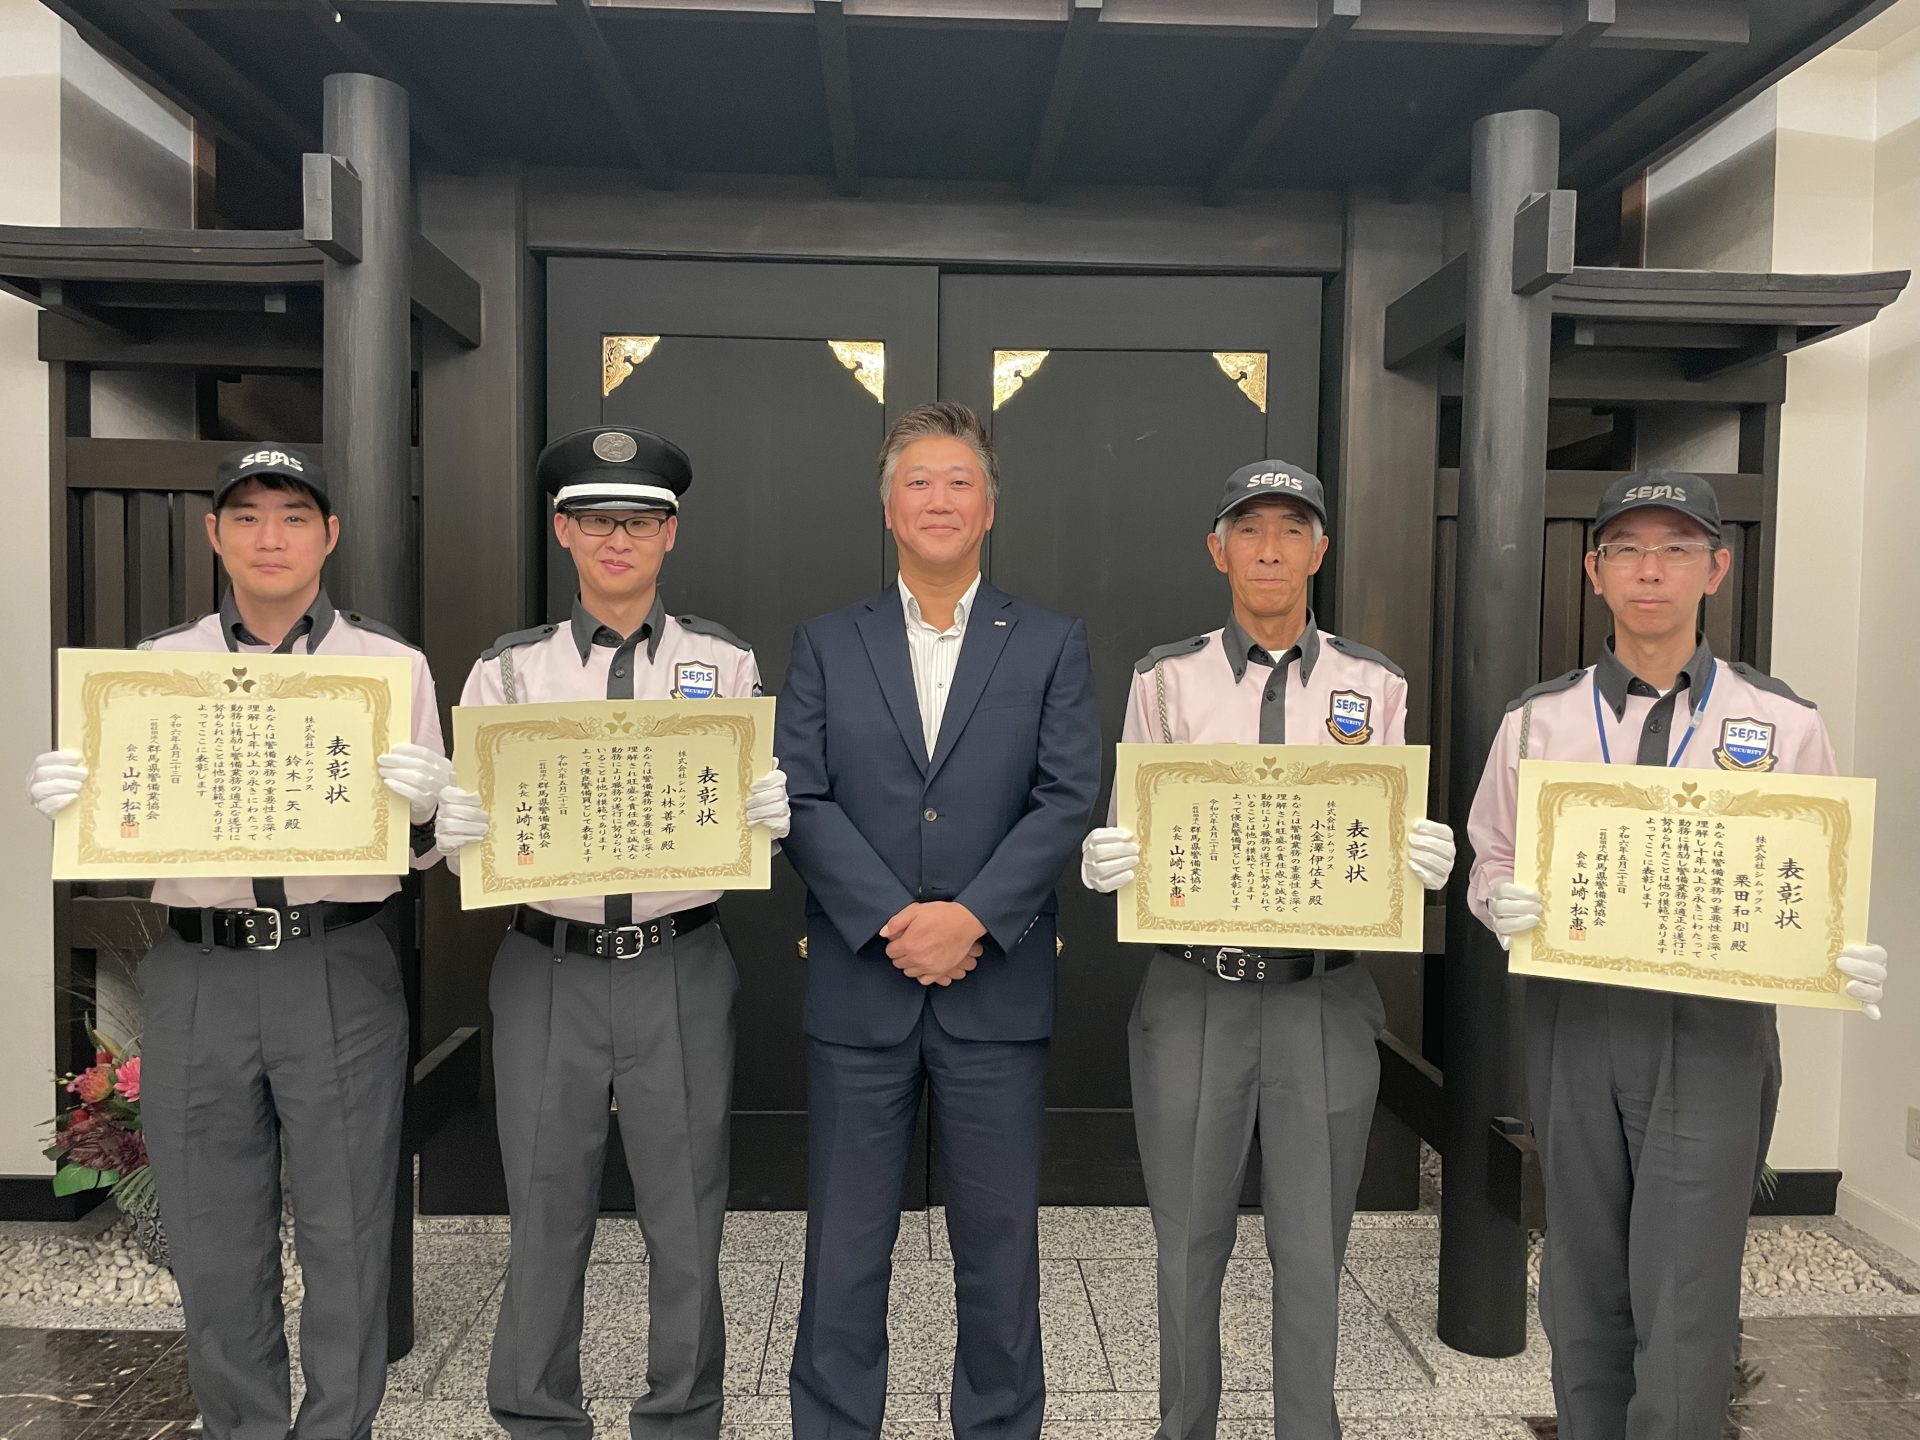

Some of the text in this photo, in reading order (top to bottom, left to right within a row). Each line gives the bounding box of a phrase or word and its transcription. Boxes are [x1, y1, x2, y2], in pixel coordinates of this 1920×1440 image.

[1336, 717, 1362, 726] SECURITY
[1728, 746, 1763, 755] SECURITY
[325, 735, 351, 804] 表彰状
[696, 766, 719, 826] 表彰状
[1345, 819, 1369, 883] 表彰状
[1774, 857, 1805, 930] 表彰状
